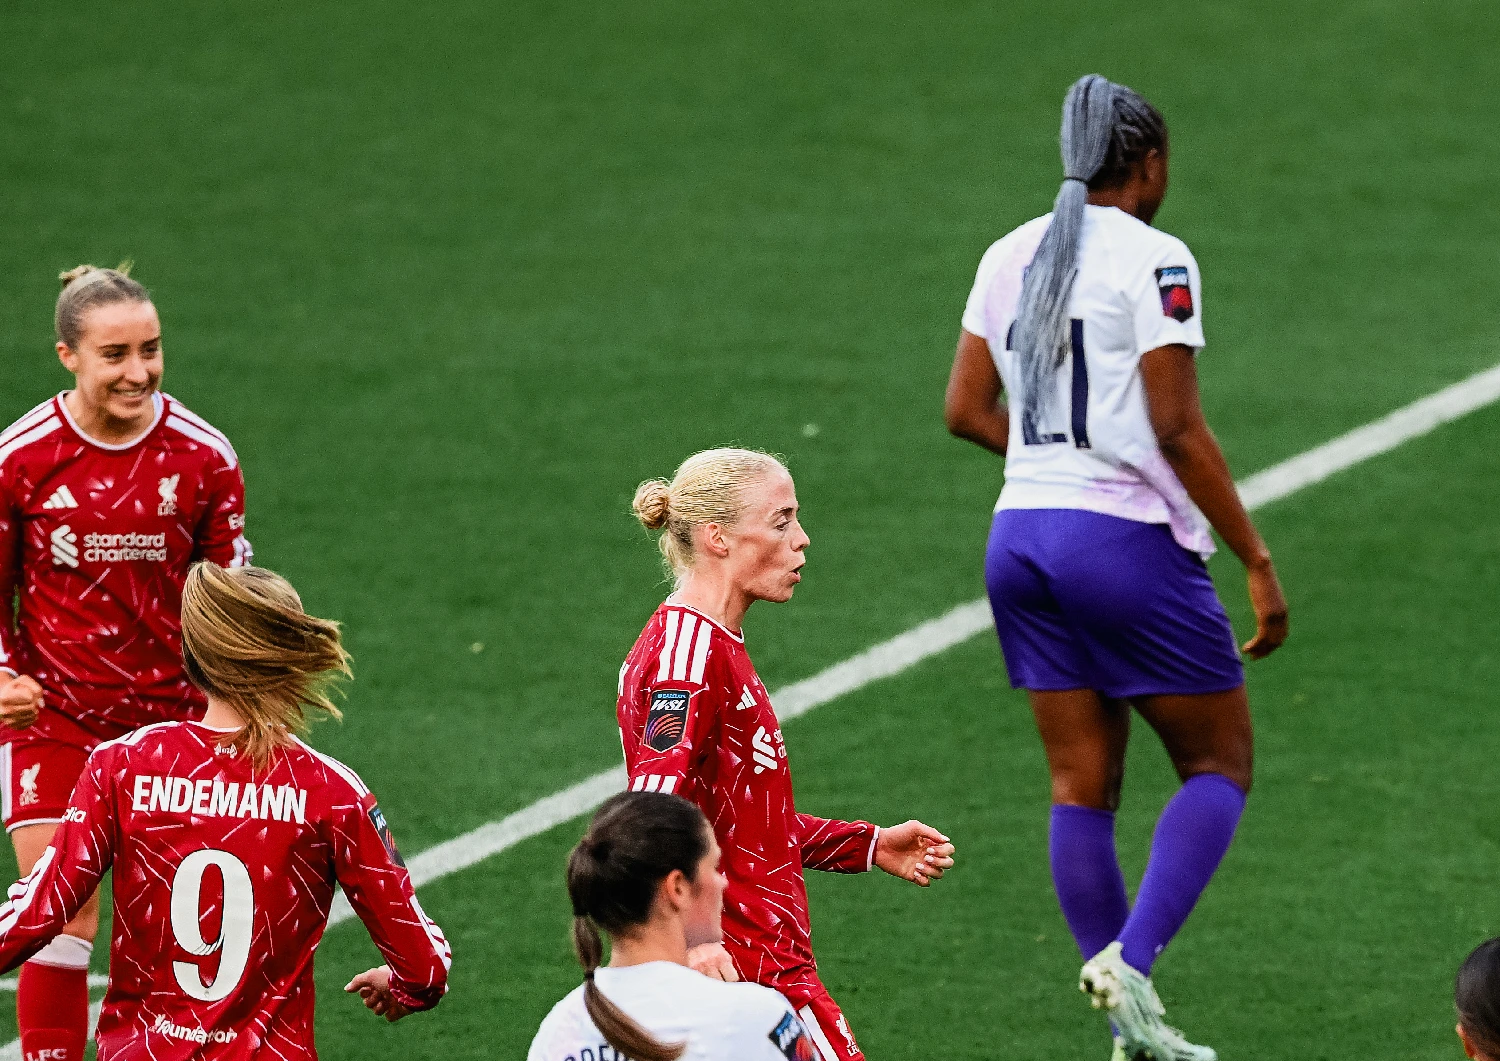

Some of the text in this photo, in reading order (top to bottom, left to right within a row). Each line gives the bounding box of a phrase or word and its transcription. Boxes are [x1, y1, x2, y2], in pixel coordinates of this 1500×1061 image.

[83, 532, 166, 548] standard
[83, 547, 168, 562] chartered
[650, 699, 686, 711] WSL
[133, 774, 307, 824] ENDEMANN
[171, 848, 255, 1002] 9
